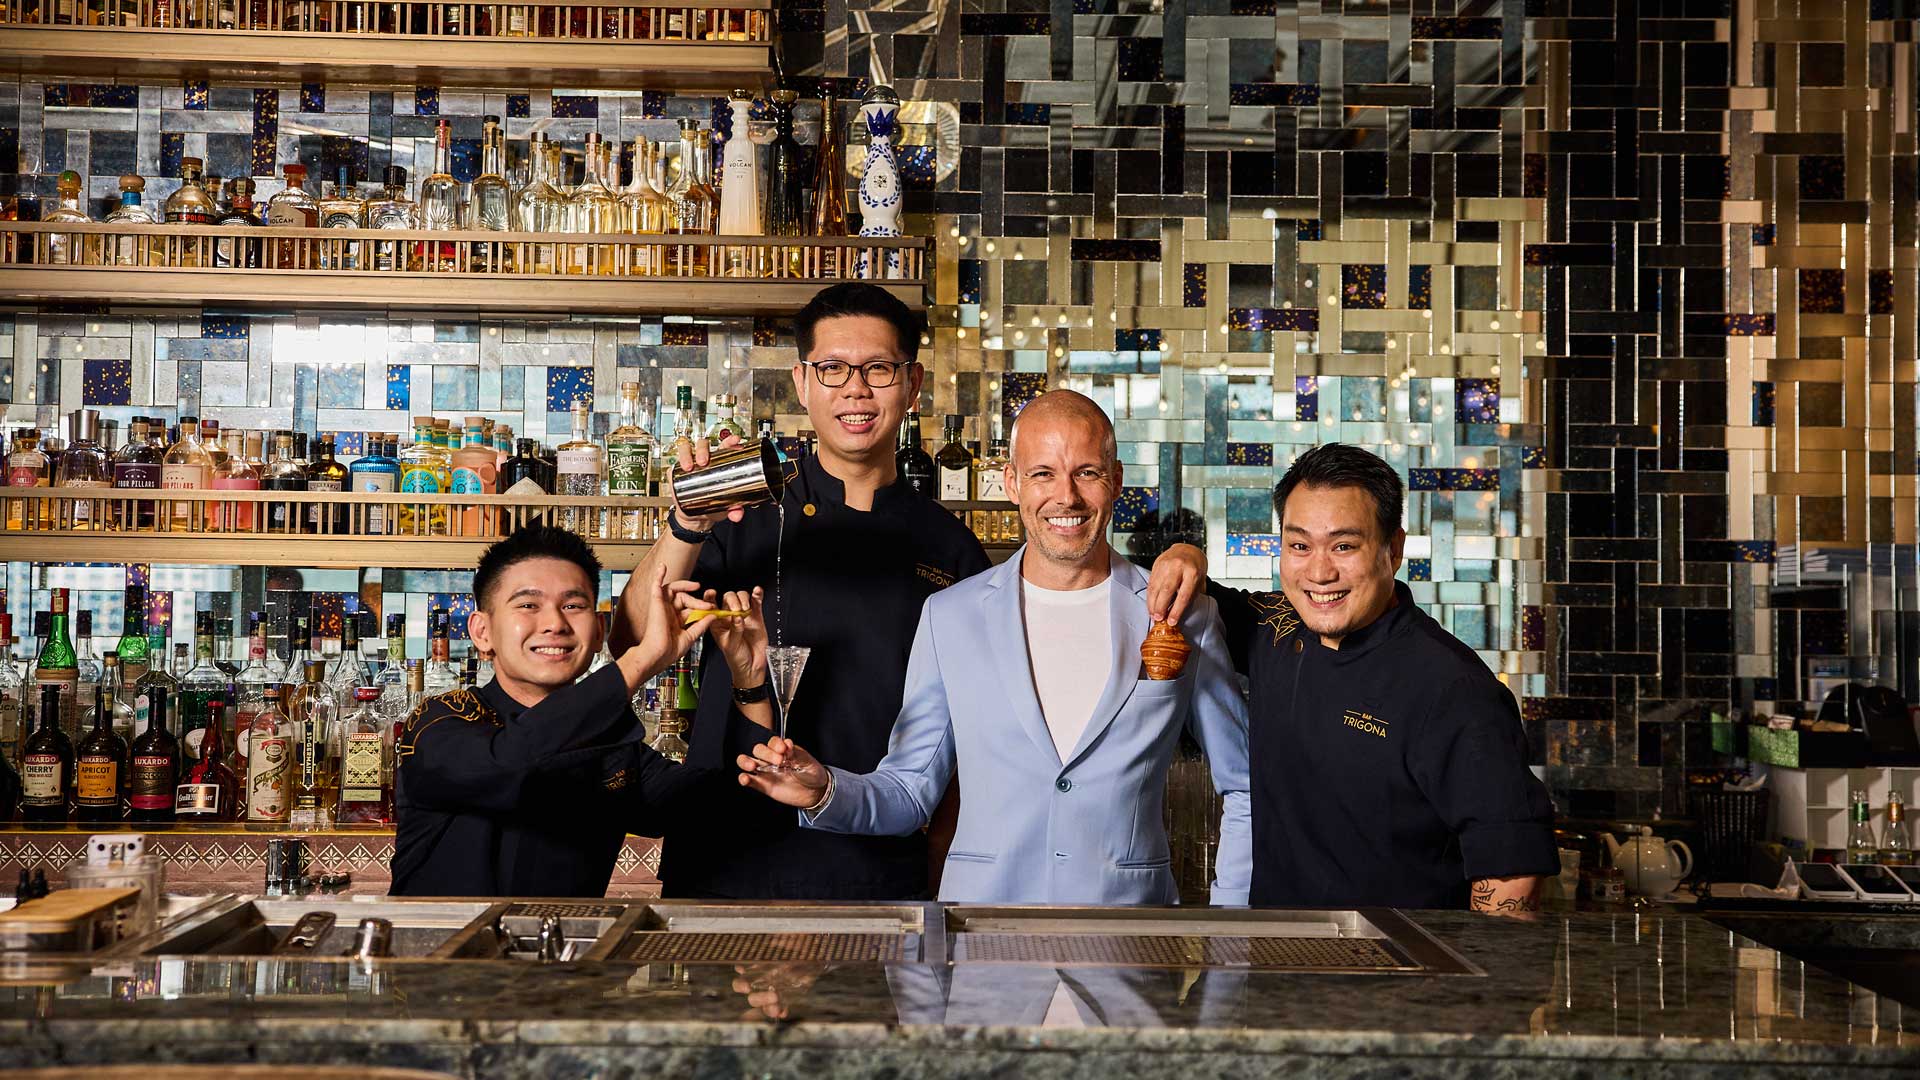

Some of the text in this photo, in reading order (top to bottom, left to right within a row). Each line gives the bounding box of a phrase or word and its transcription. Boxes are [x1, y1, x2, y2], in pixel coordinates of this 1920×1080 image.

[131, 480, 155, 488] PILLARS
[616, 480, 638, 490] GIN
[915, 567, 950, 587] TRIGON
[1343, 715, 1386, 738] TRIGONA
[26, 765, 54, 773] CHERRY
[81, 766, 110, 774] APRICOT
